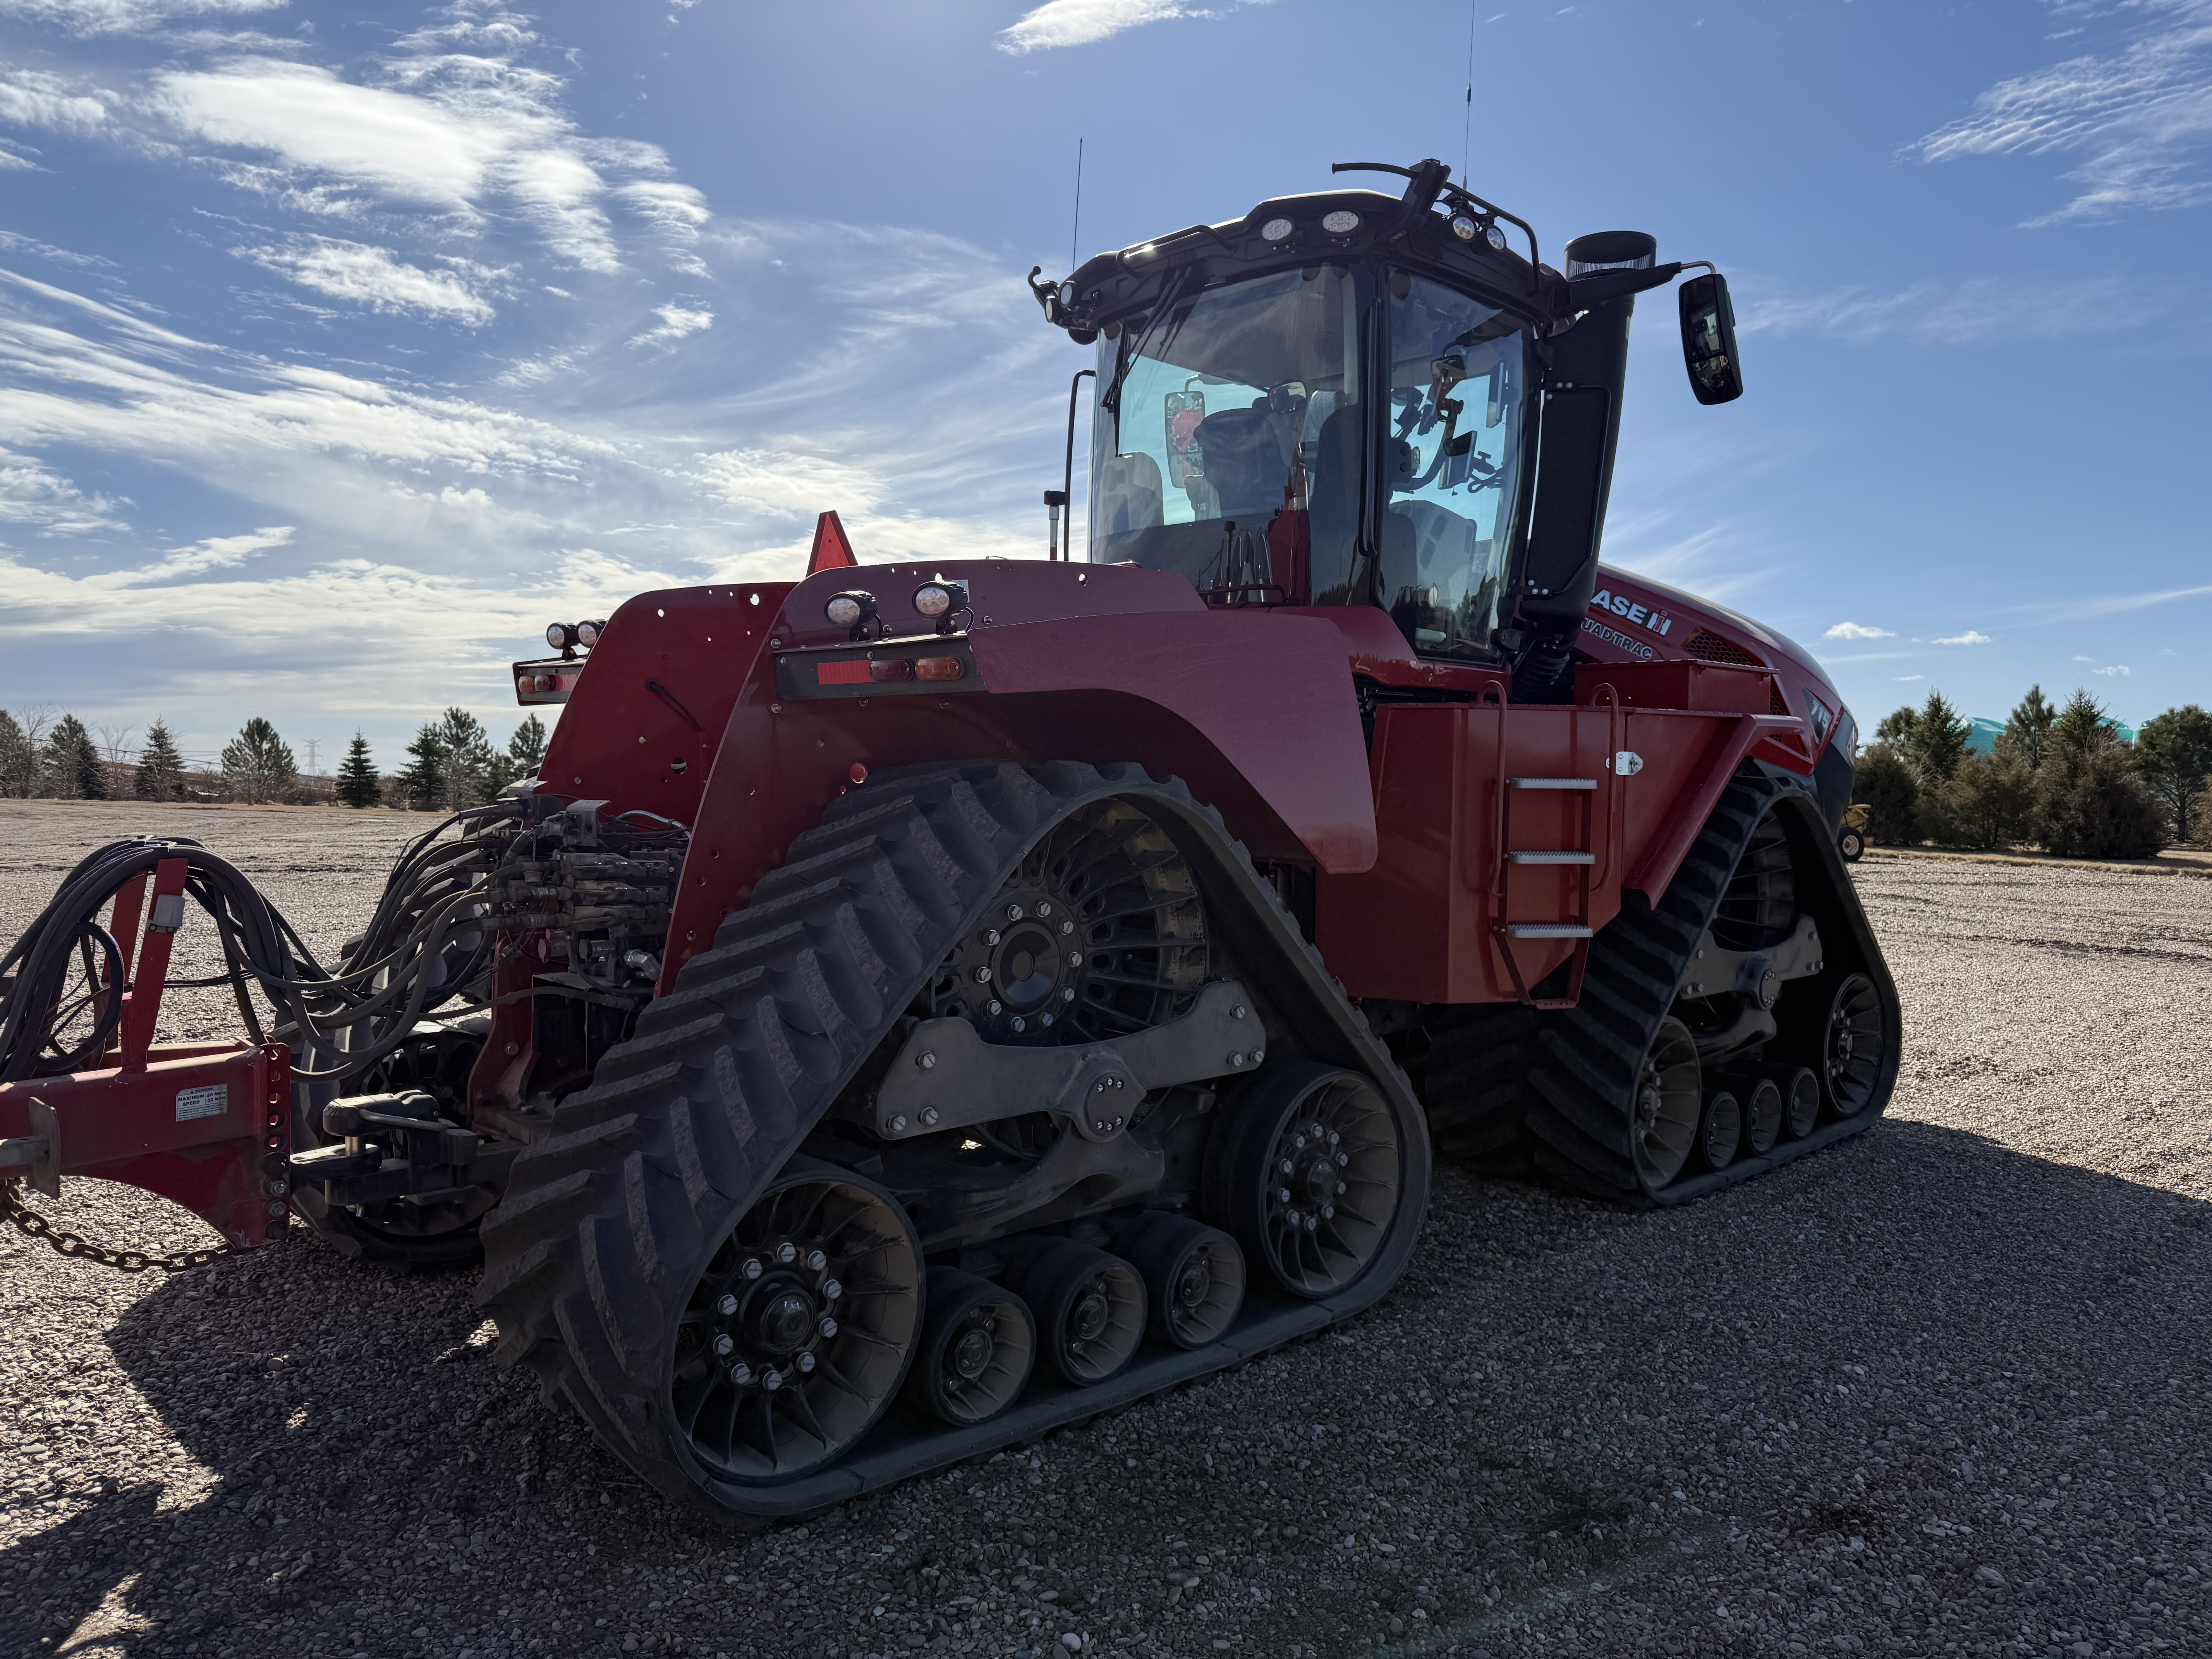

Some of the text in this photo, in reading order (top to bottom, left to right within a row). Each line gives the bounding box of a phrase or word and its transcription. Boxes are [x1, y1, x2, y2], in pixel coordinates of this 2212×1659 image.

[1590, 589, 1648, 625] ASE
[1581, 617, 1652, 660] UADTRAC
[1810, 699, 1830, 729] 715
